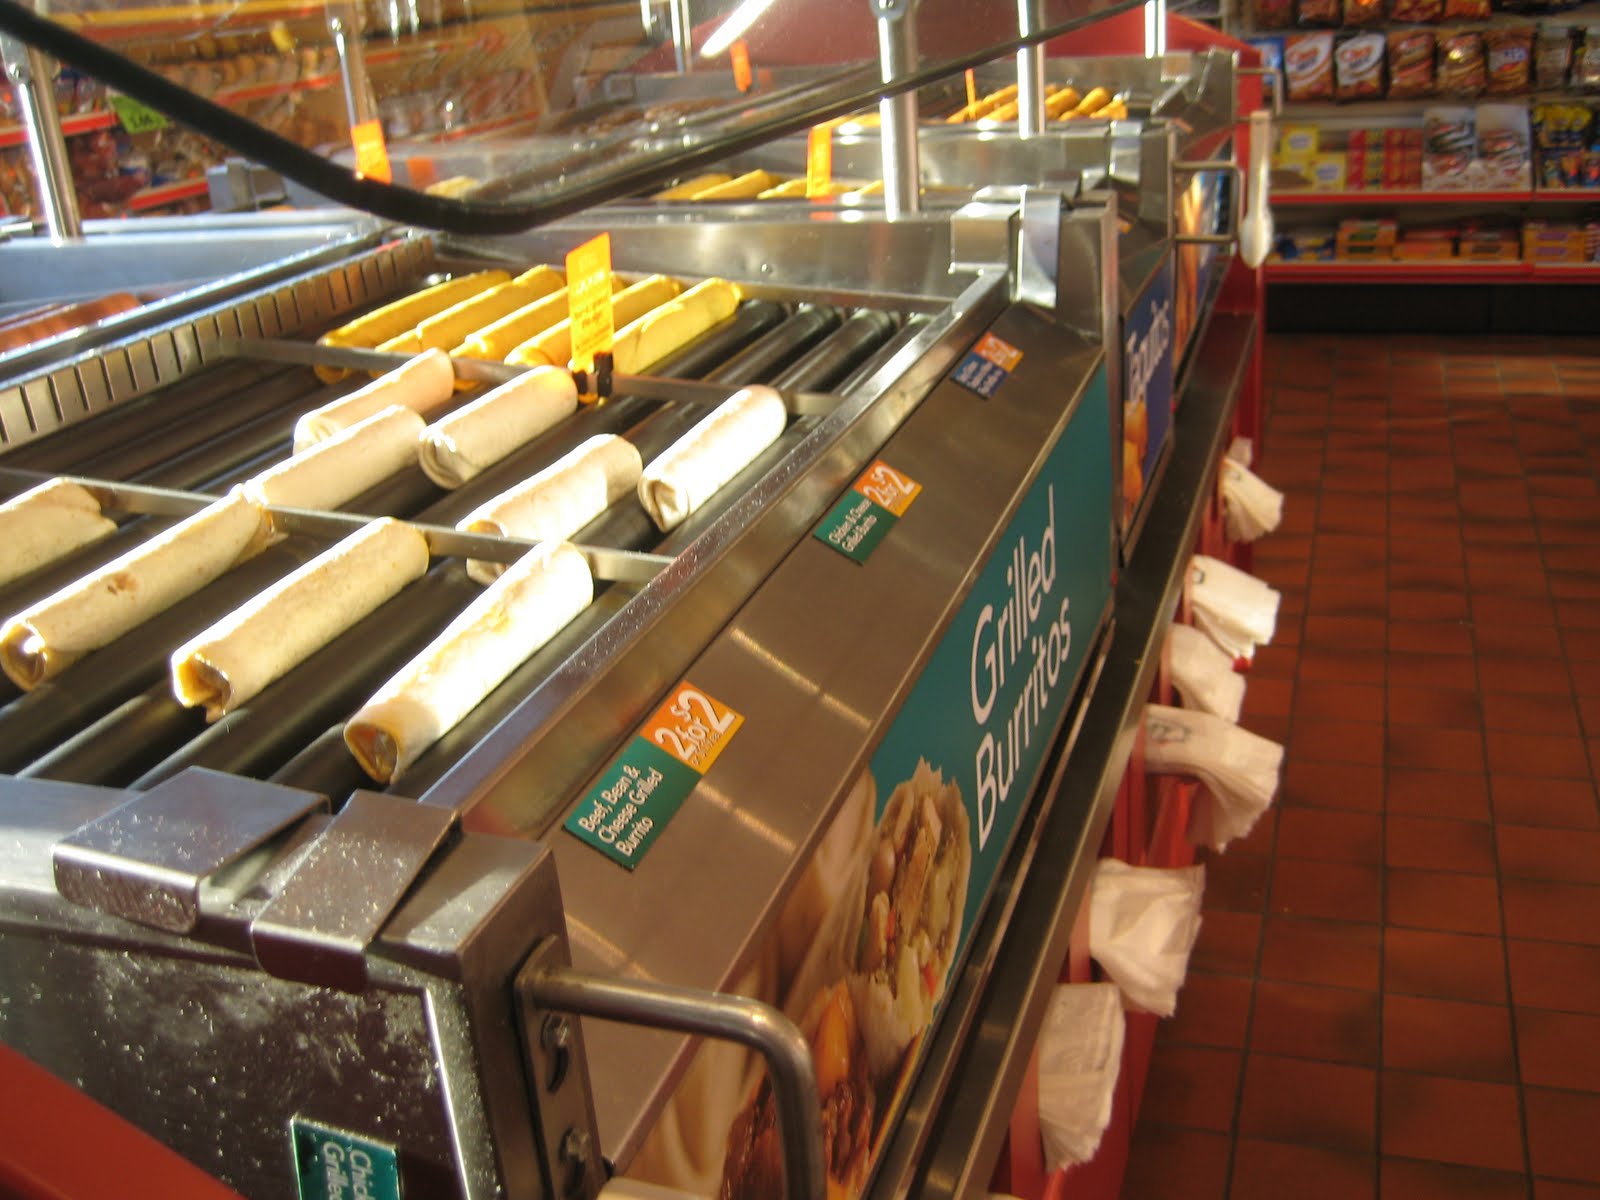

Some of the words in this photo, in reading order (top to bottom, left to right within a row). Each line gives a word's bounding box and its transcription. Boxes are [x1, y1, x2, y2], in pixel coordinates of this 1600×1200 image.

[971, 482, 1056, 725] Grilled
[654, 727, 693, 760] 2
[675, 715, 711, 748] for
[976, 597, 1071, 853] Burritos
[578, 799, 612, 833] Beef,
[601, 775, 633, 805] Bean
[623, 764, 641, 779] &
[598, 802, 638, 844] Cheese
[629, 766, 664, 806] Grilled
[615, 816, 654, 857] Burrito
